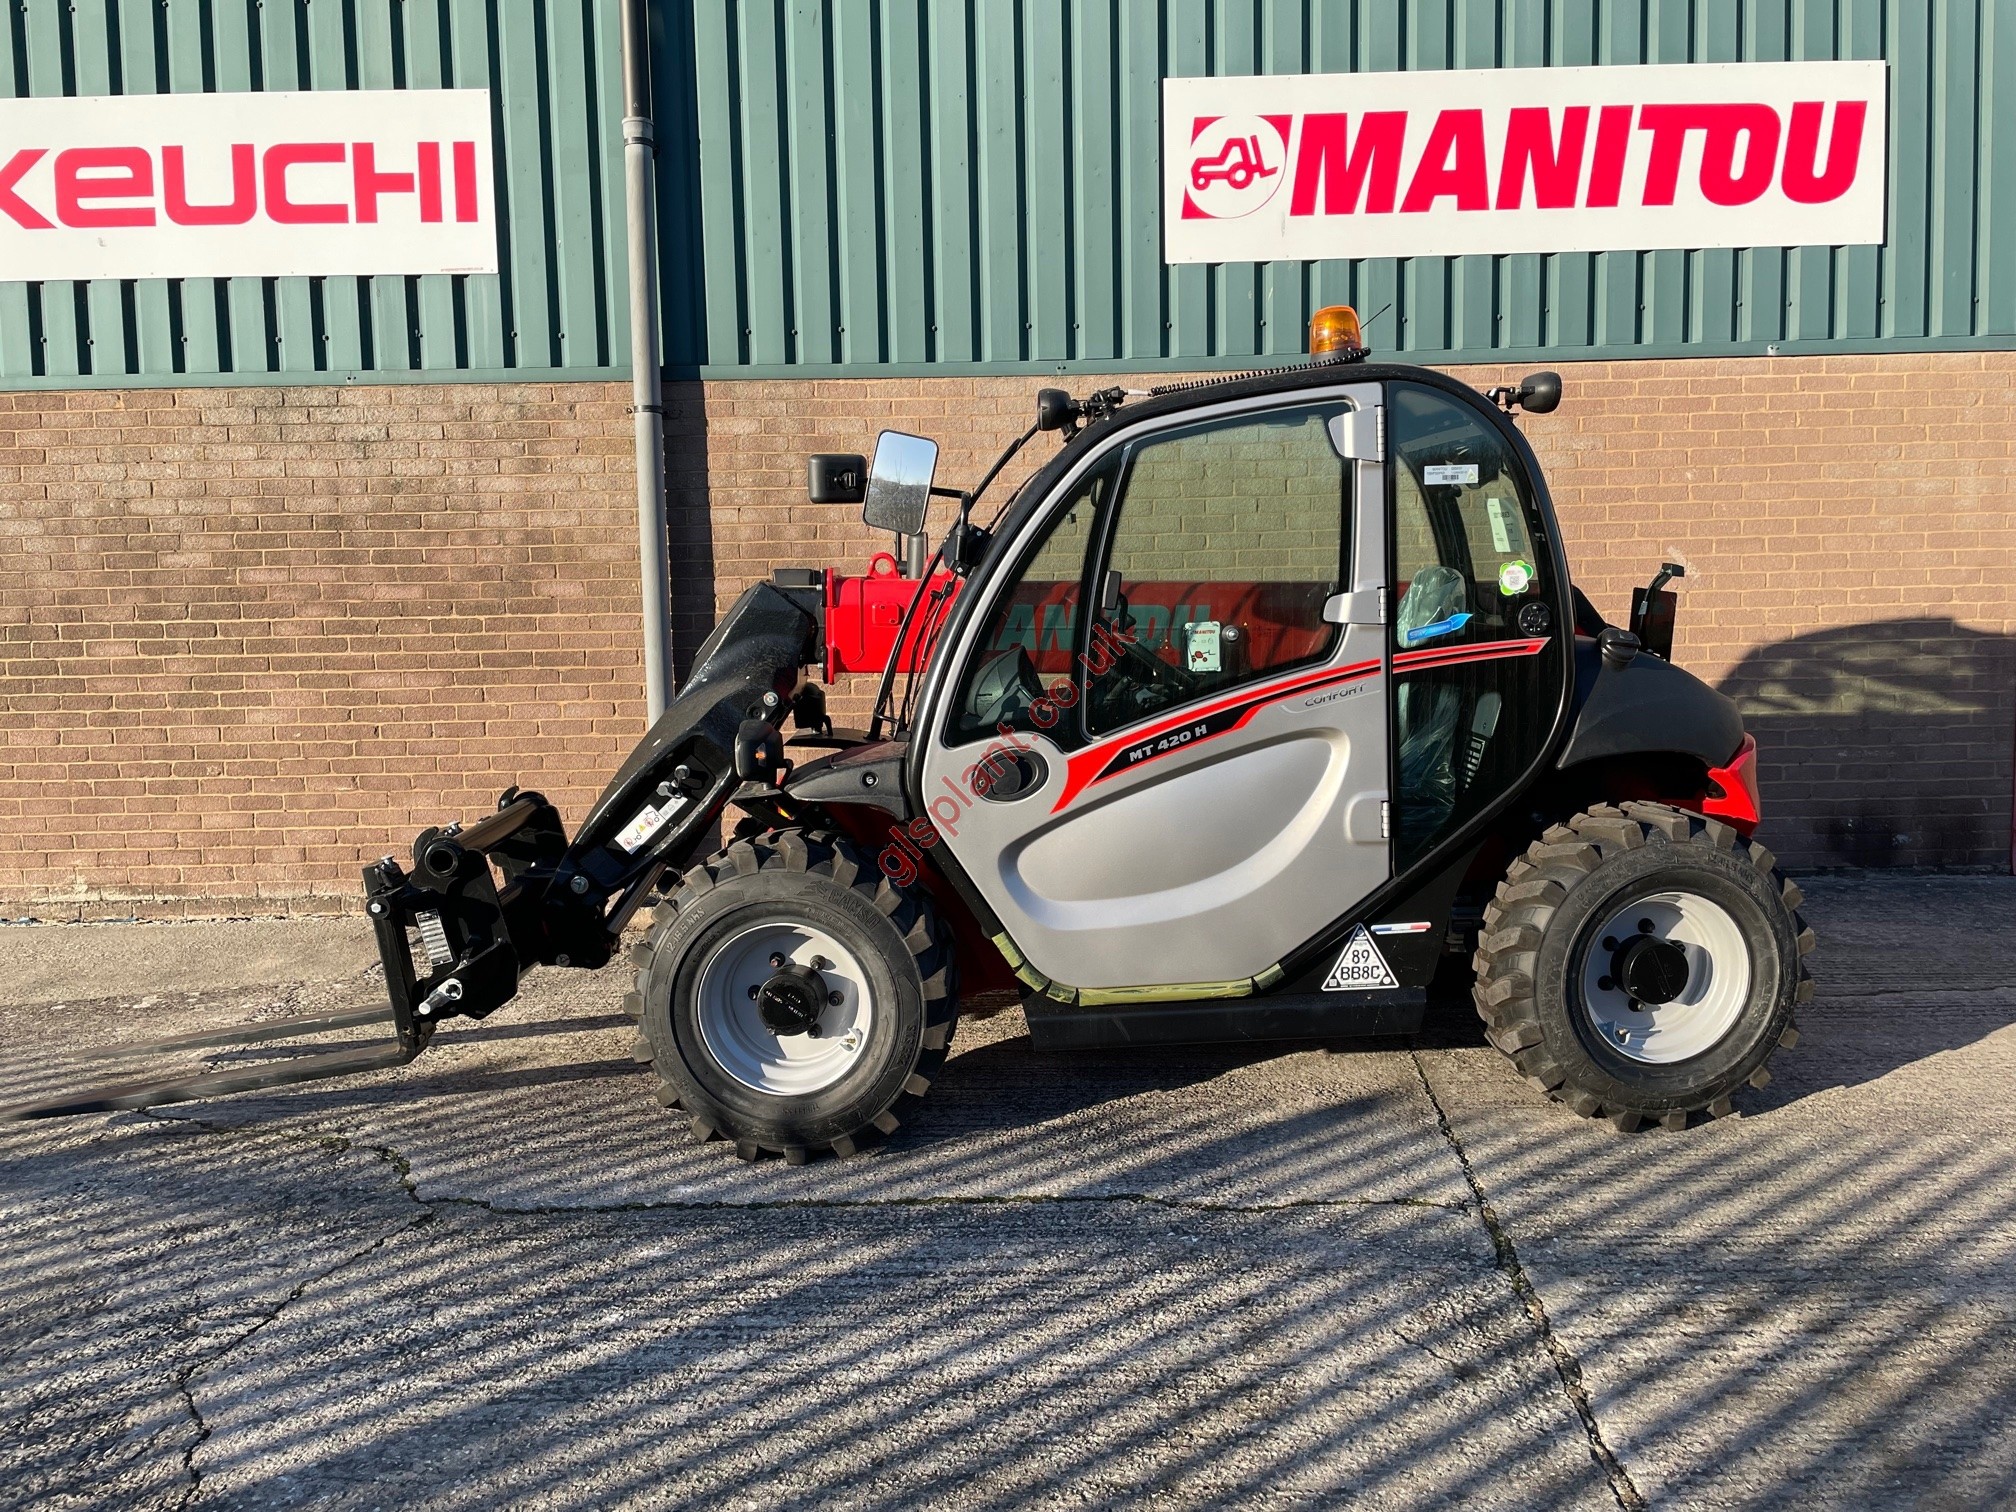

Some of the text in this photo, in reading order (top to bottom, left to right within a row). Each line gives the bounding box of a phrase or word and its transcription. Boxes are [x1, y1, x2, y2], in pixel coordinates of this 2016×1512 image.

[1289, 100, 1869, 217] MANITOU
[1129, 724, 1207, 762] MT 420 H
[1352, 949, 1370, 964] 89
[1340, 966, 1380, 980] BB8C
